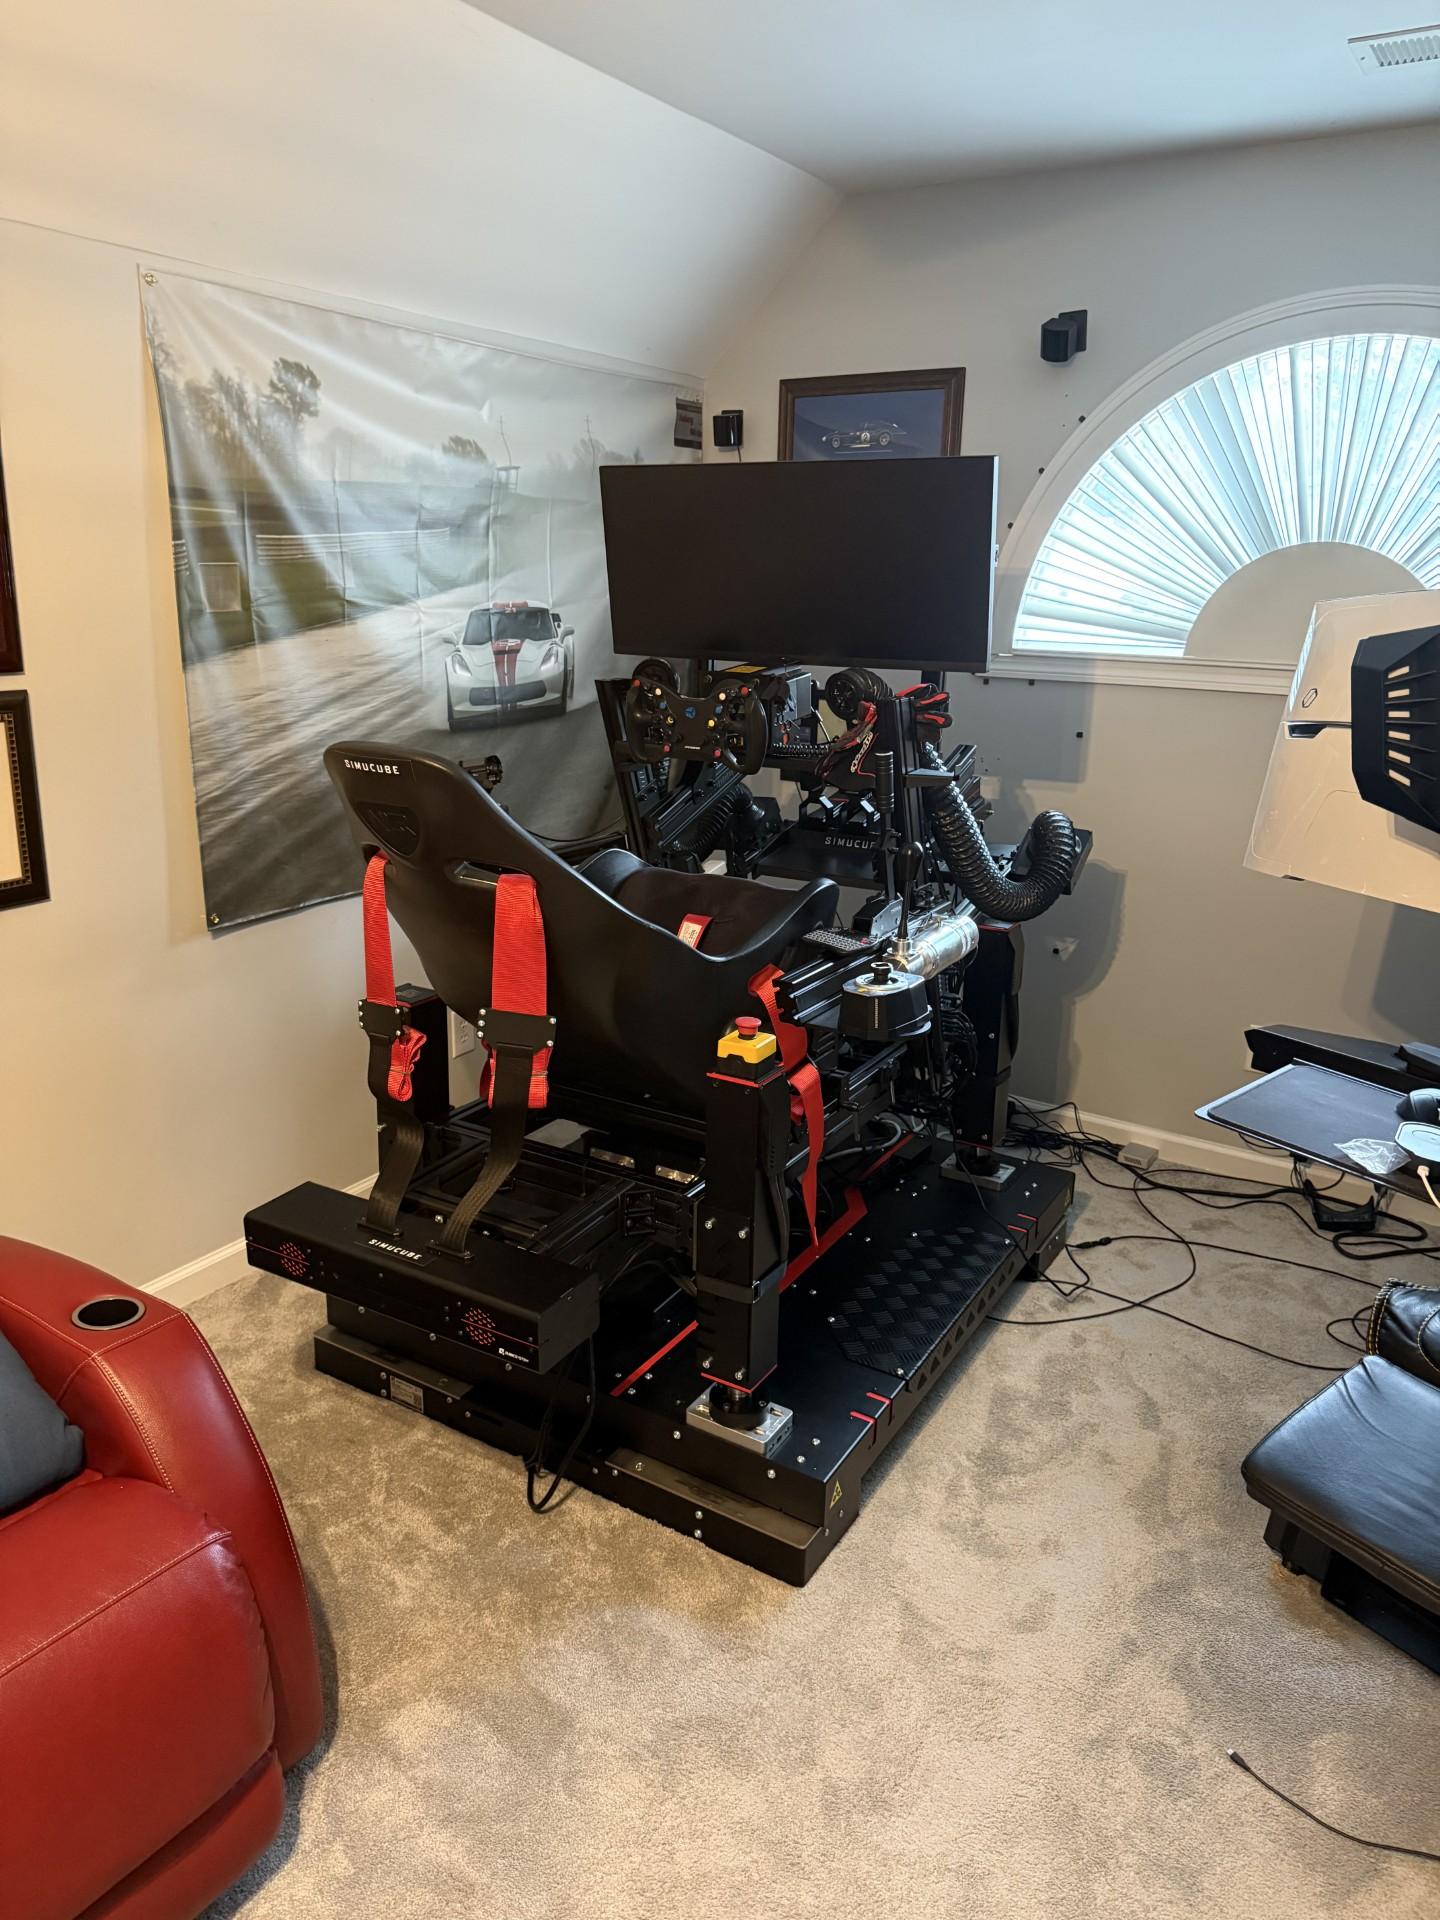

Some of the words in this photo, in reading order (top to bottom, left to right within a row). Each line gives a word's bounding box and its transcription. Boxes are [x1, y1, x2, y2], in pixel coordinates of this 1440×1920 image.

[344, 759, 400, 775] SIMUCUBE
[824, 836, 876, 849] SIMUCU
[368, 1239, 423, 1260] SIMUCUBE
